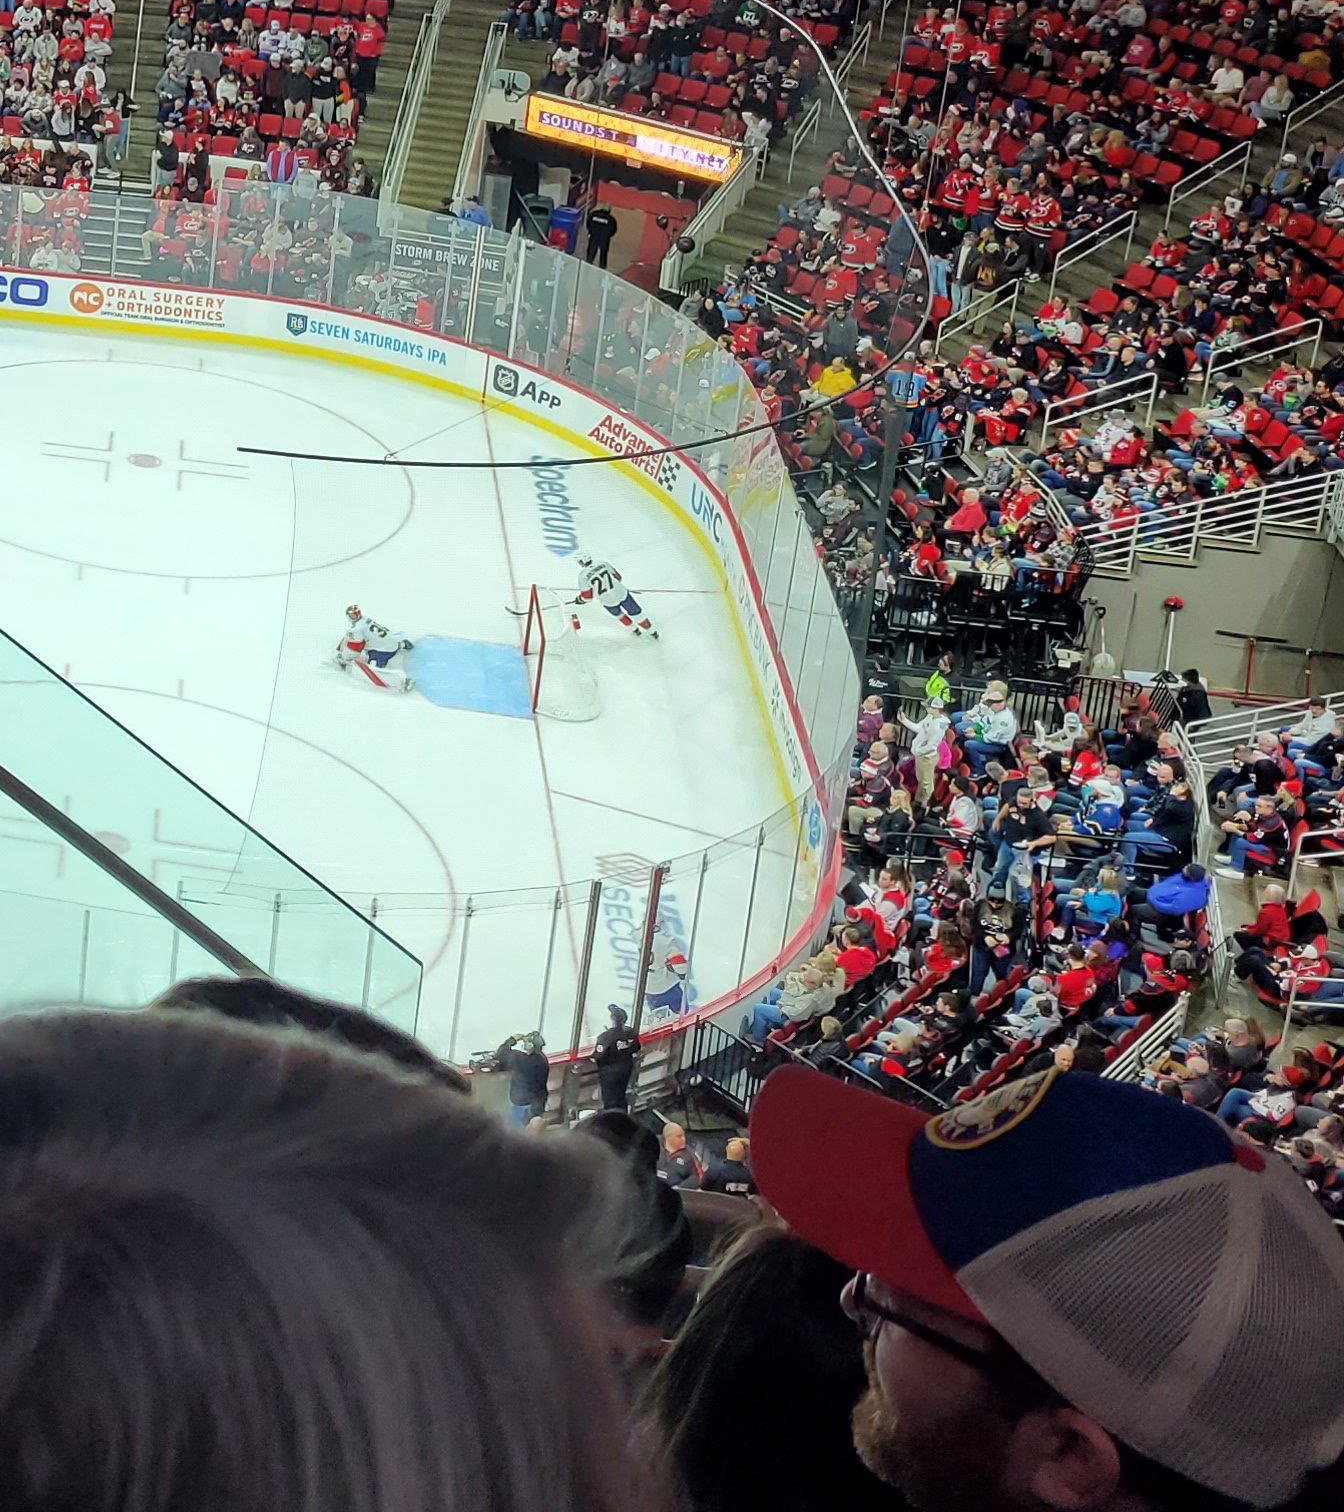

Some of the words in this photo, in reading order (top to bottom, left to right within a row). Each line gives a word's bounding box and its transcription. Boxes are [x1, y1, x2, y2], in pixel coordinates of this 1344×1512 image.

[394, 243, 433, 261] STORM
[435, 249, 469, 267] BREW
[106, 286, 147, 301] ORAL
[153, 291, 226, 309] SURGERY
[116, 300, 224, 322] ORTHODONTICS
[309, 319, 350, 341] SEVEN
[353, 328, 424, 359] SATURDAYS
[427, 347, 447, 366] IPA
[587, 426, 623, 454] Auto
[623, 447, 656, 478] Parts
[598, 414, 661, 464] Advance
[591, 569, 614, 596] 27
